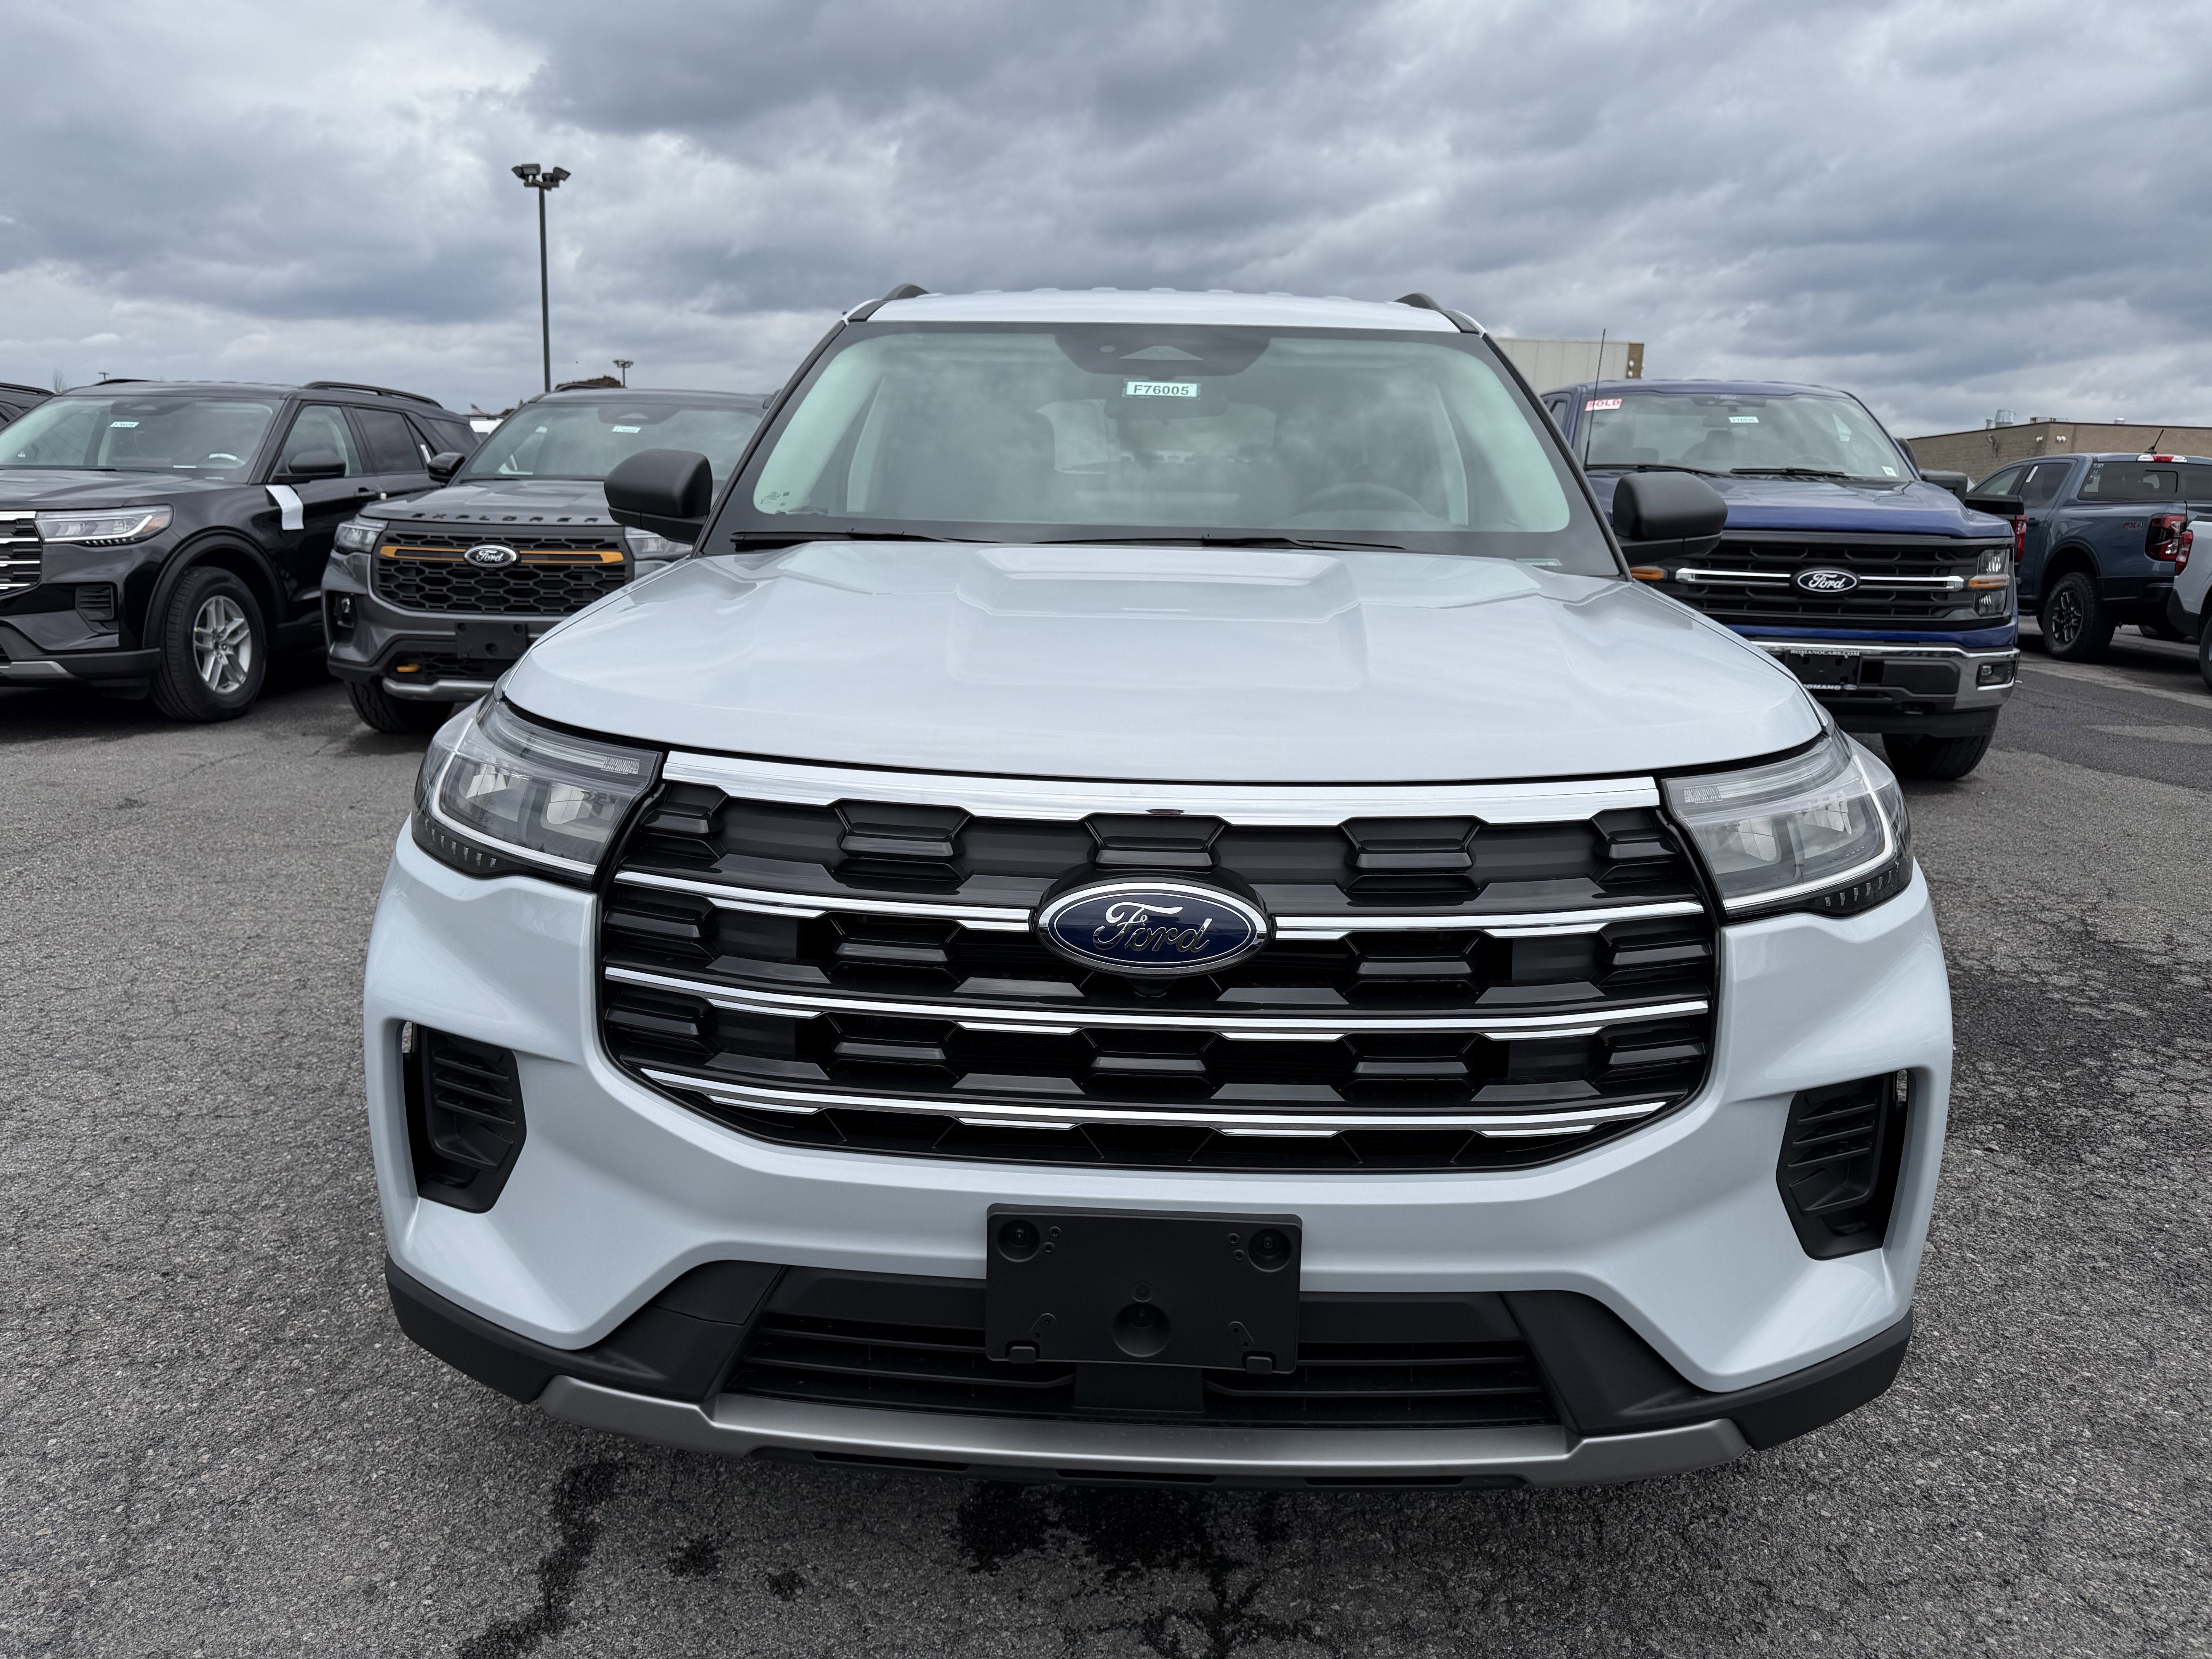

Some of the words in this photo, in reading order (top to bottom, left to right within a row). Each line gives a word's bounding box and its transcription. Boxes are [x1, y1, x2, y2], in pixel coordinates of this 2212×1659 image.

[1134, 385, 1188, 395] F76005
[412, 513, 599, 522] EXPLORER
[476, 549, 504, 562] Ford
[1808, 573, 1846, 589] Ford
[1093, 902, 1213, 952] Ford
